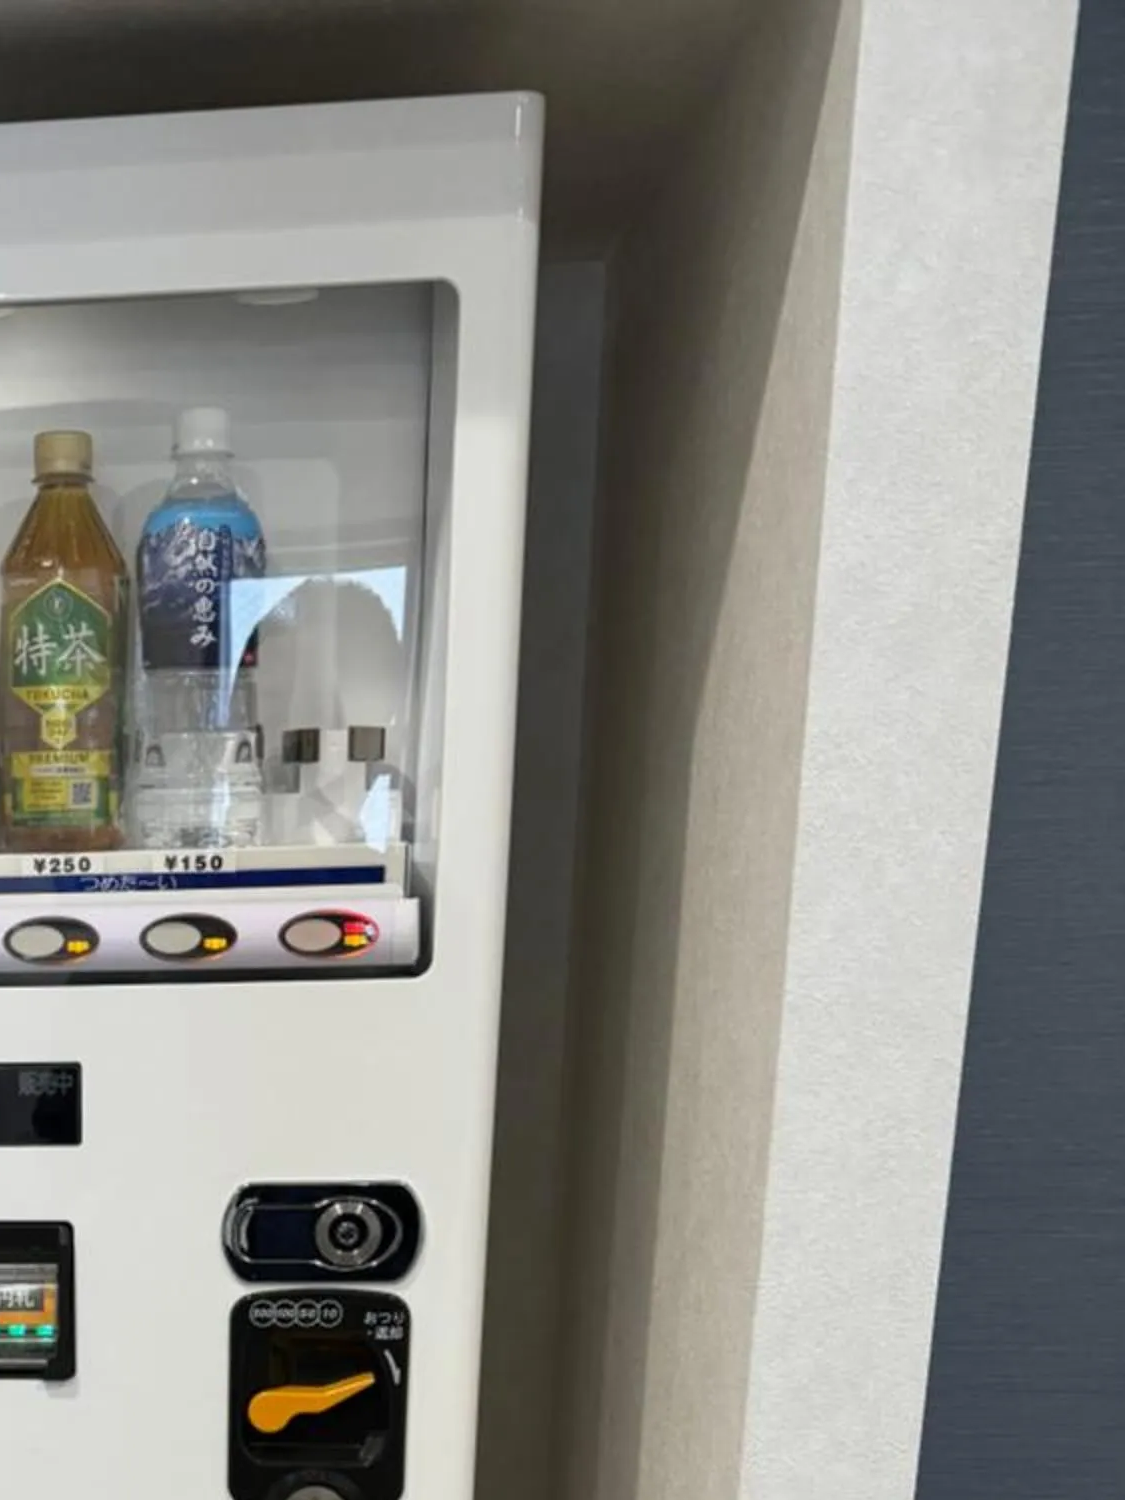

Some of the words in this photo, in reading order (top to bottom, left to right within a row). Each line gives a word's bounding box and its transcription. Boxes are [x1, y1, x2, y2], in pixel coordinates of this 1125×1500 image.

[14, 621, 107, 678] 特茶
[33, 856, 92, 873] ¥250
[164, 855, 224, 871] ¥150
